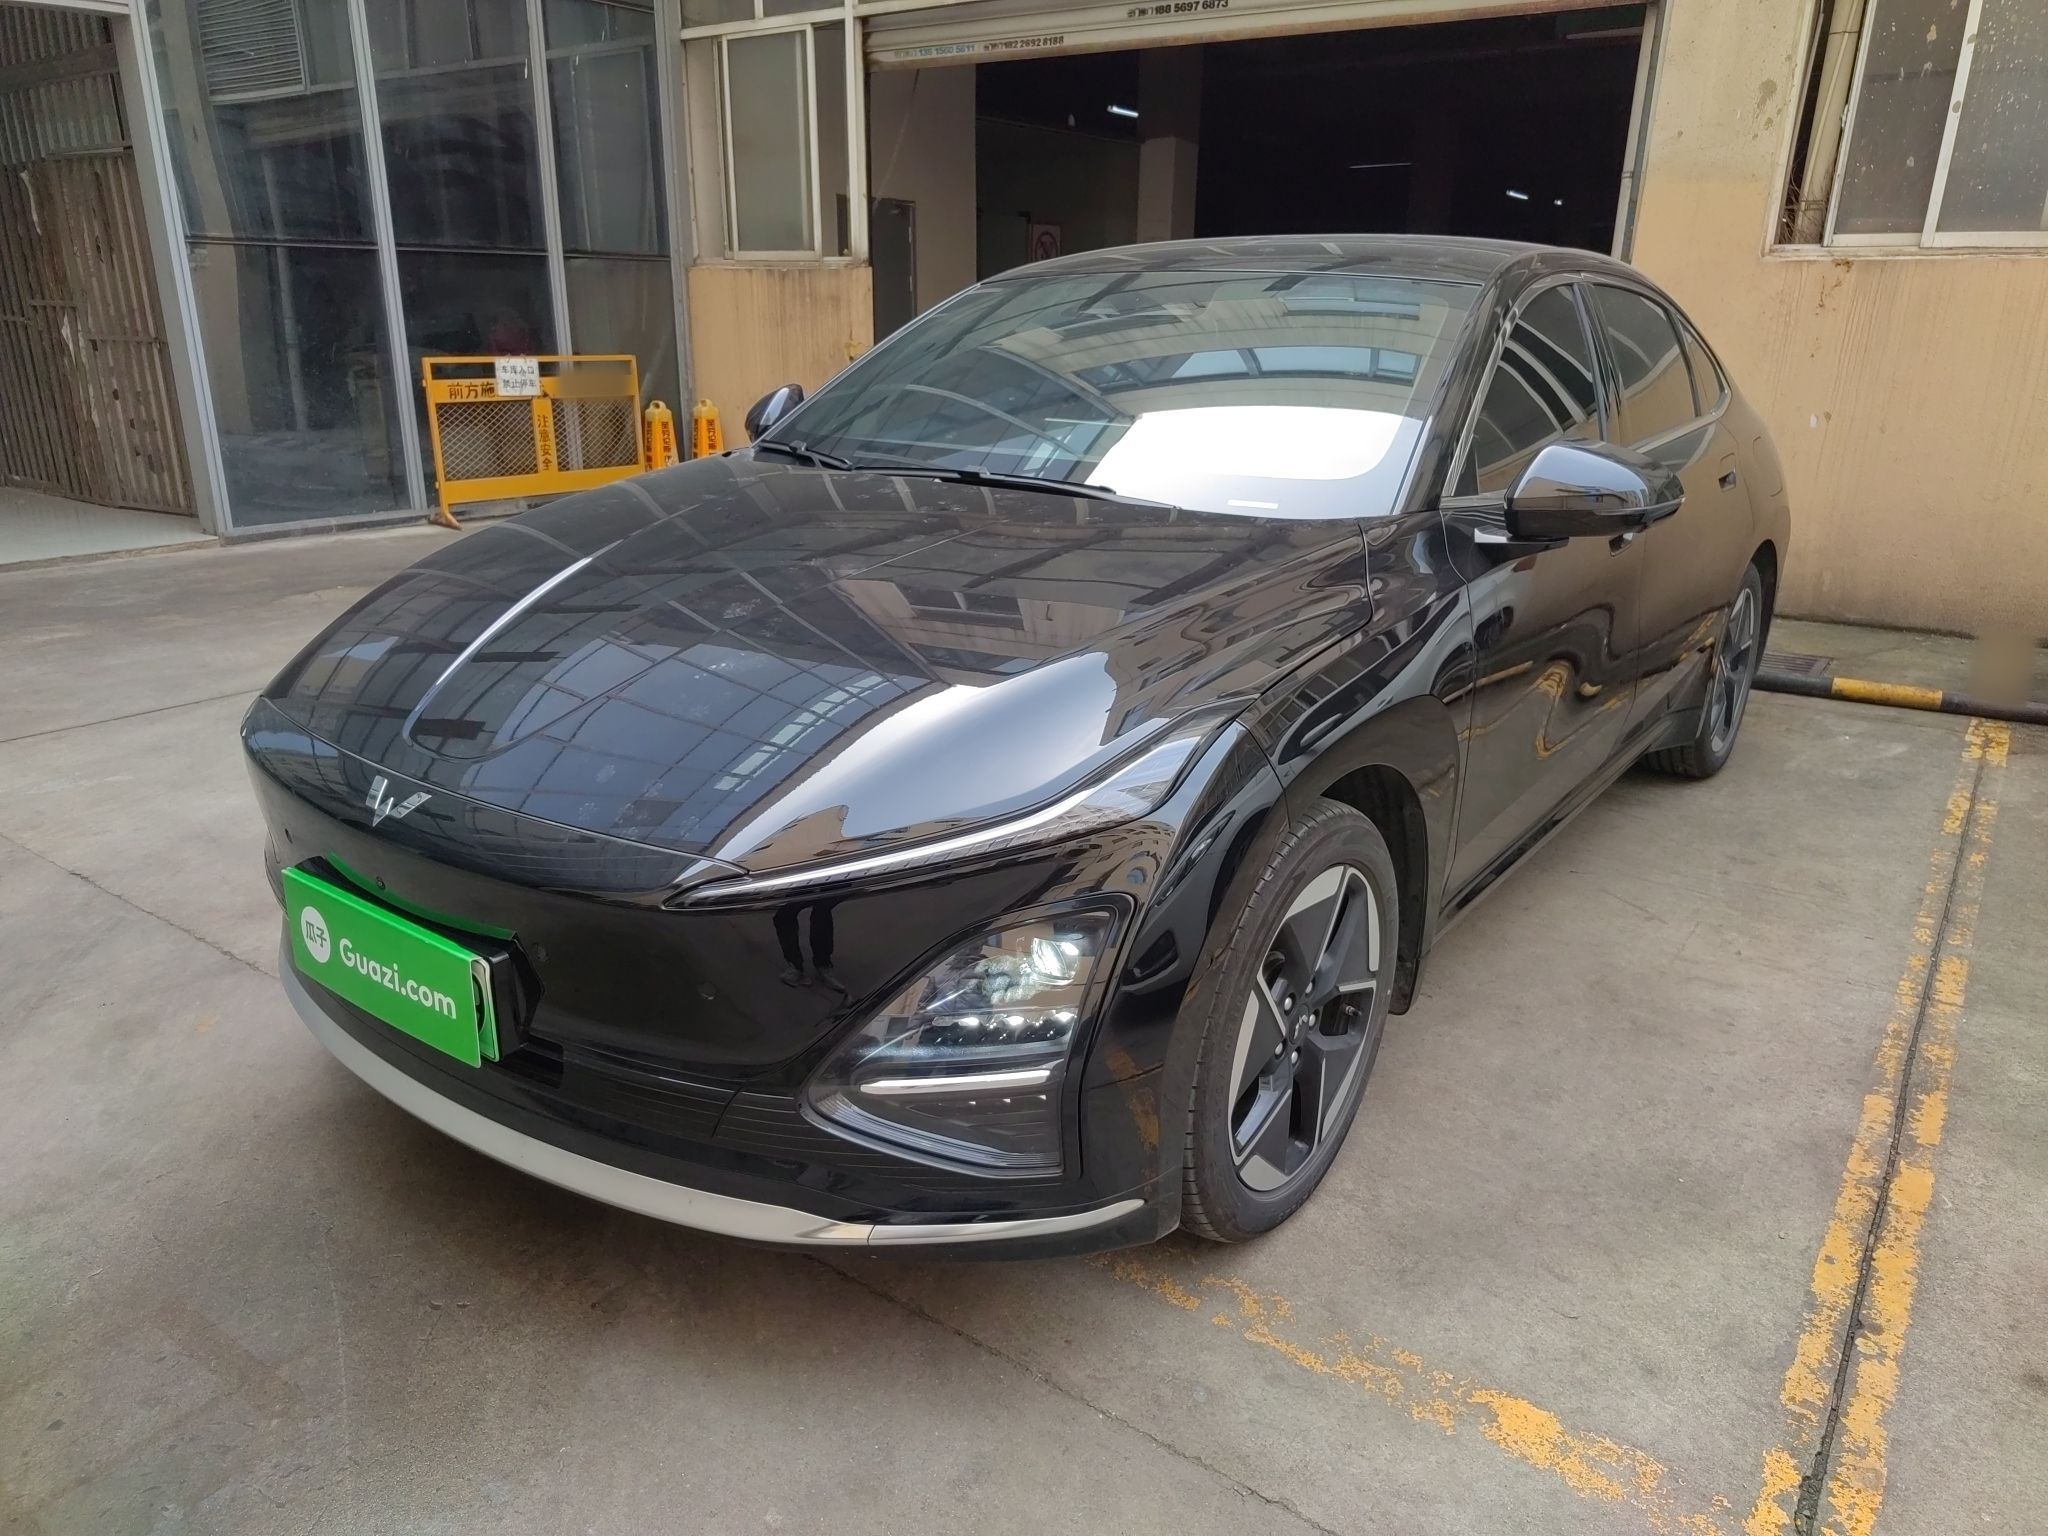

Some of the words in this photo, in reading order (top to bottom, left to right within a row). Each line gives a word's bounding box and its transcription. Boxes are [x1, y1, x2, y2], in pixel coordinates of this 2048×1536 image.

[1173, 1, 1200, 13] 5697
[501, 364, 535, 376] 车库入口
[305, 920, 327, 948] 瓜子
[339, 938, 456, 1019] Guazi.com
